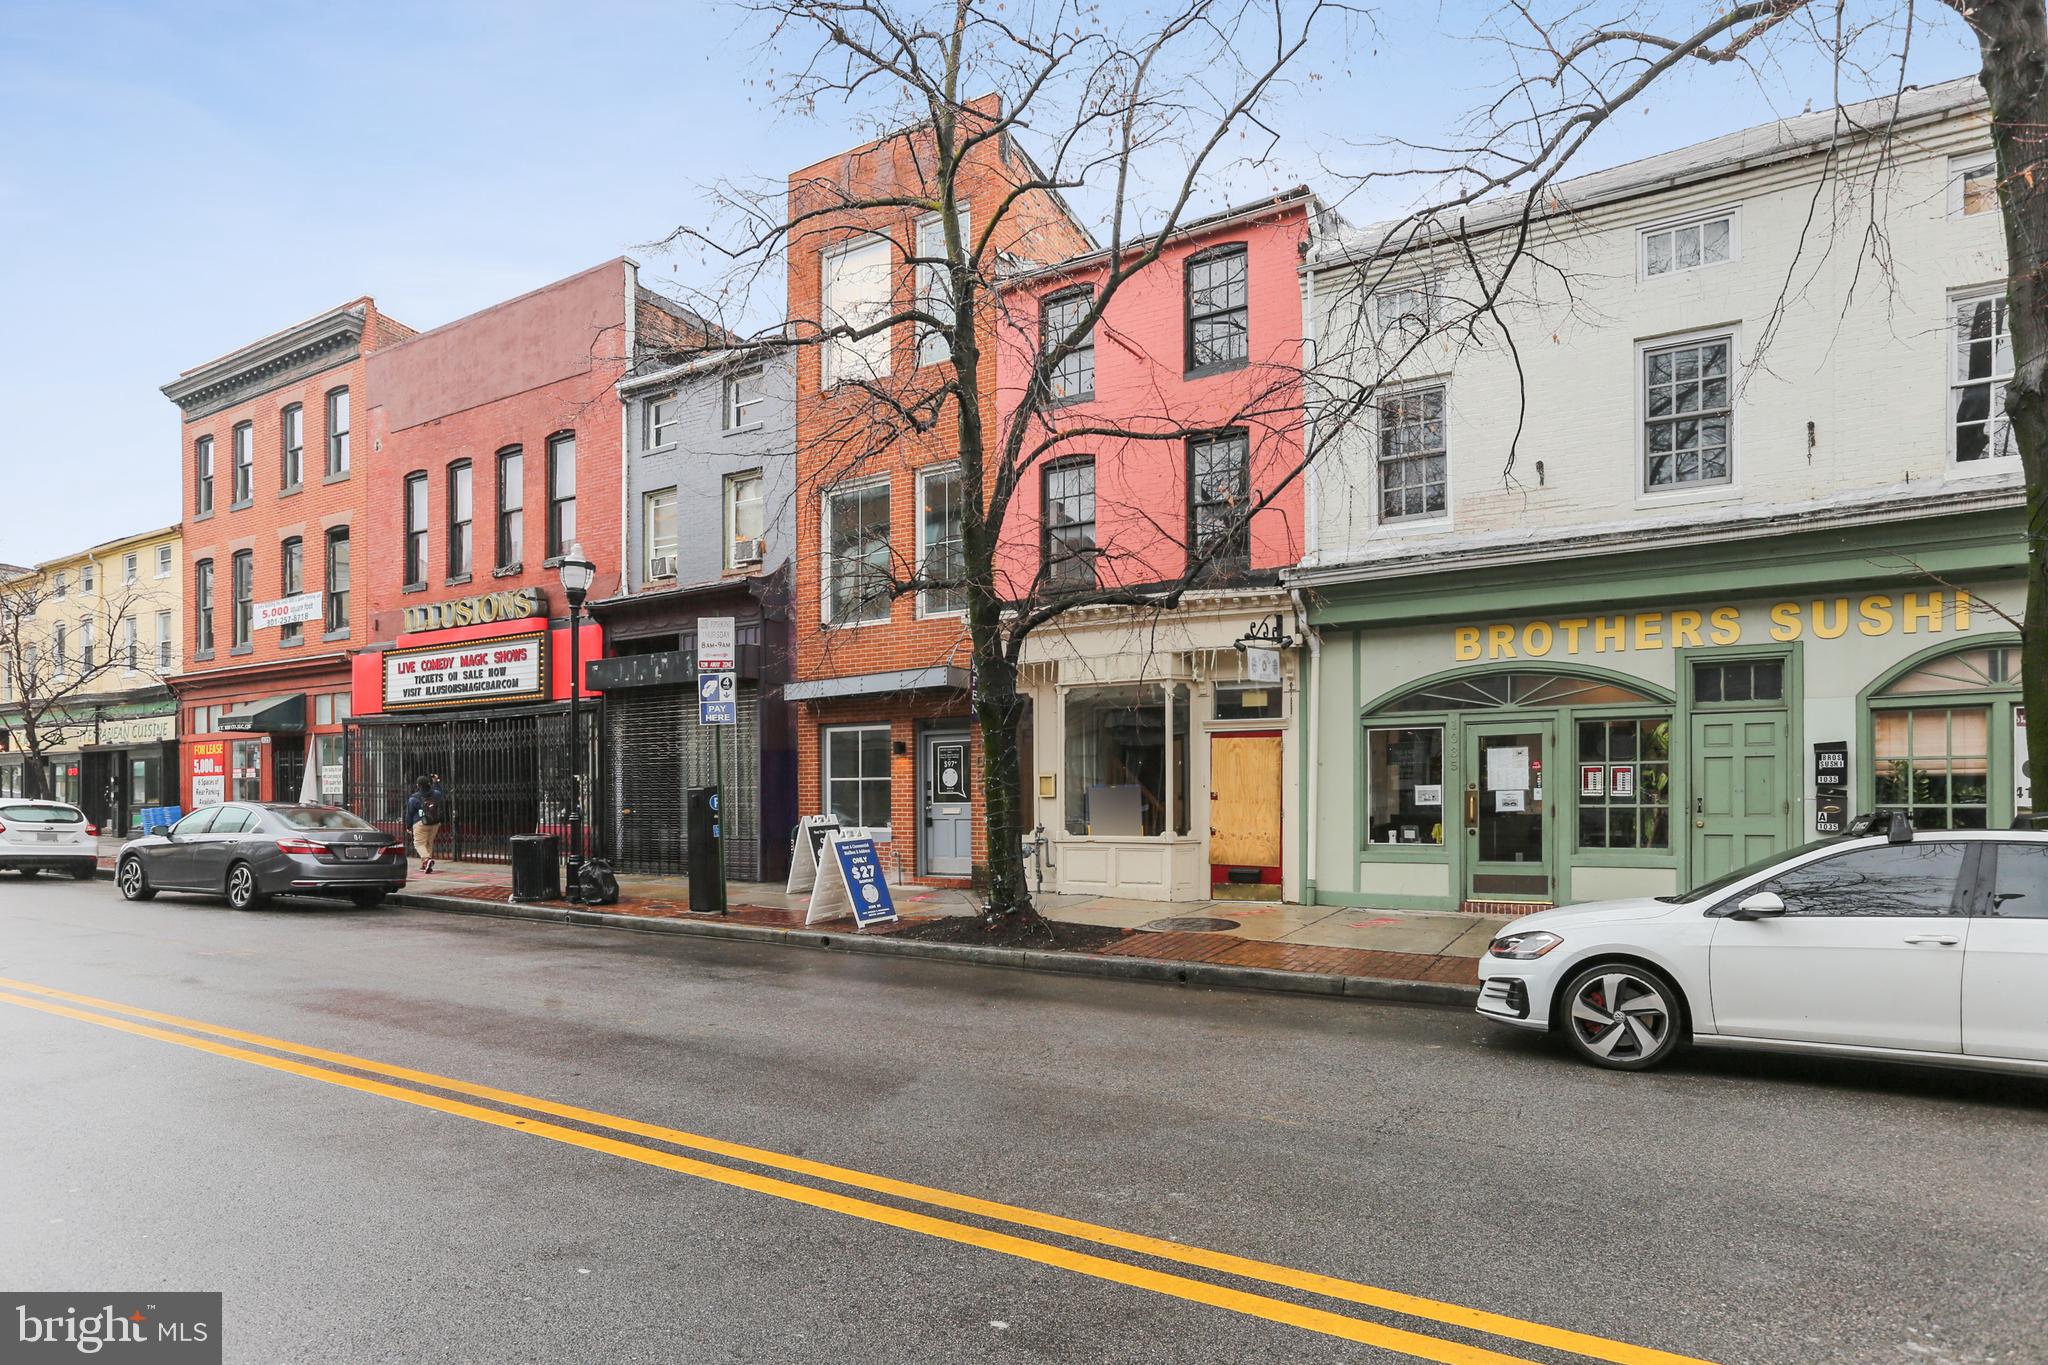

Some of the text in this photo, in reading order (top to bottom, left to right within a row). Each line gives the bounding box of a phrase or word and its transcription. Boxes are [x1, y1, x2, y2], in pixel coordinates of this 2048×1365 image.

[402, 588, 534, 633] ILLUSIONS
[1455, 589, 1971, 661] BROTHERS SUSHI
[397, 648, 527, 674] LIVE COMEDY MAGIC SHOWS
[414, 667, 506, 685] TICKETS ON SALE NOW
[403, 687, 422, 697] VISIT
[708, 705, 726, 713] PAY
[705, 713, 731, 722] HERE
[132, 722, 168, 738] CUISINE
[194, 744, 223, 755] FOR LEASE
[193, 758, 214, 774] 5,000
[1819, 812, 1826, 821] A
[852, 856, 867, 864] ONLY
[851, 865, 875, 880] $27
